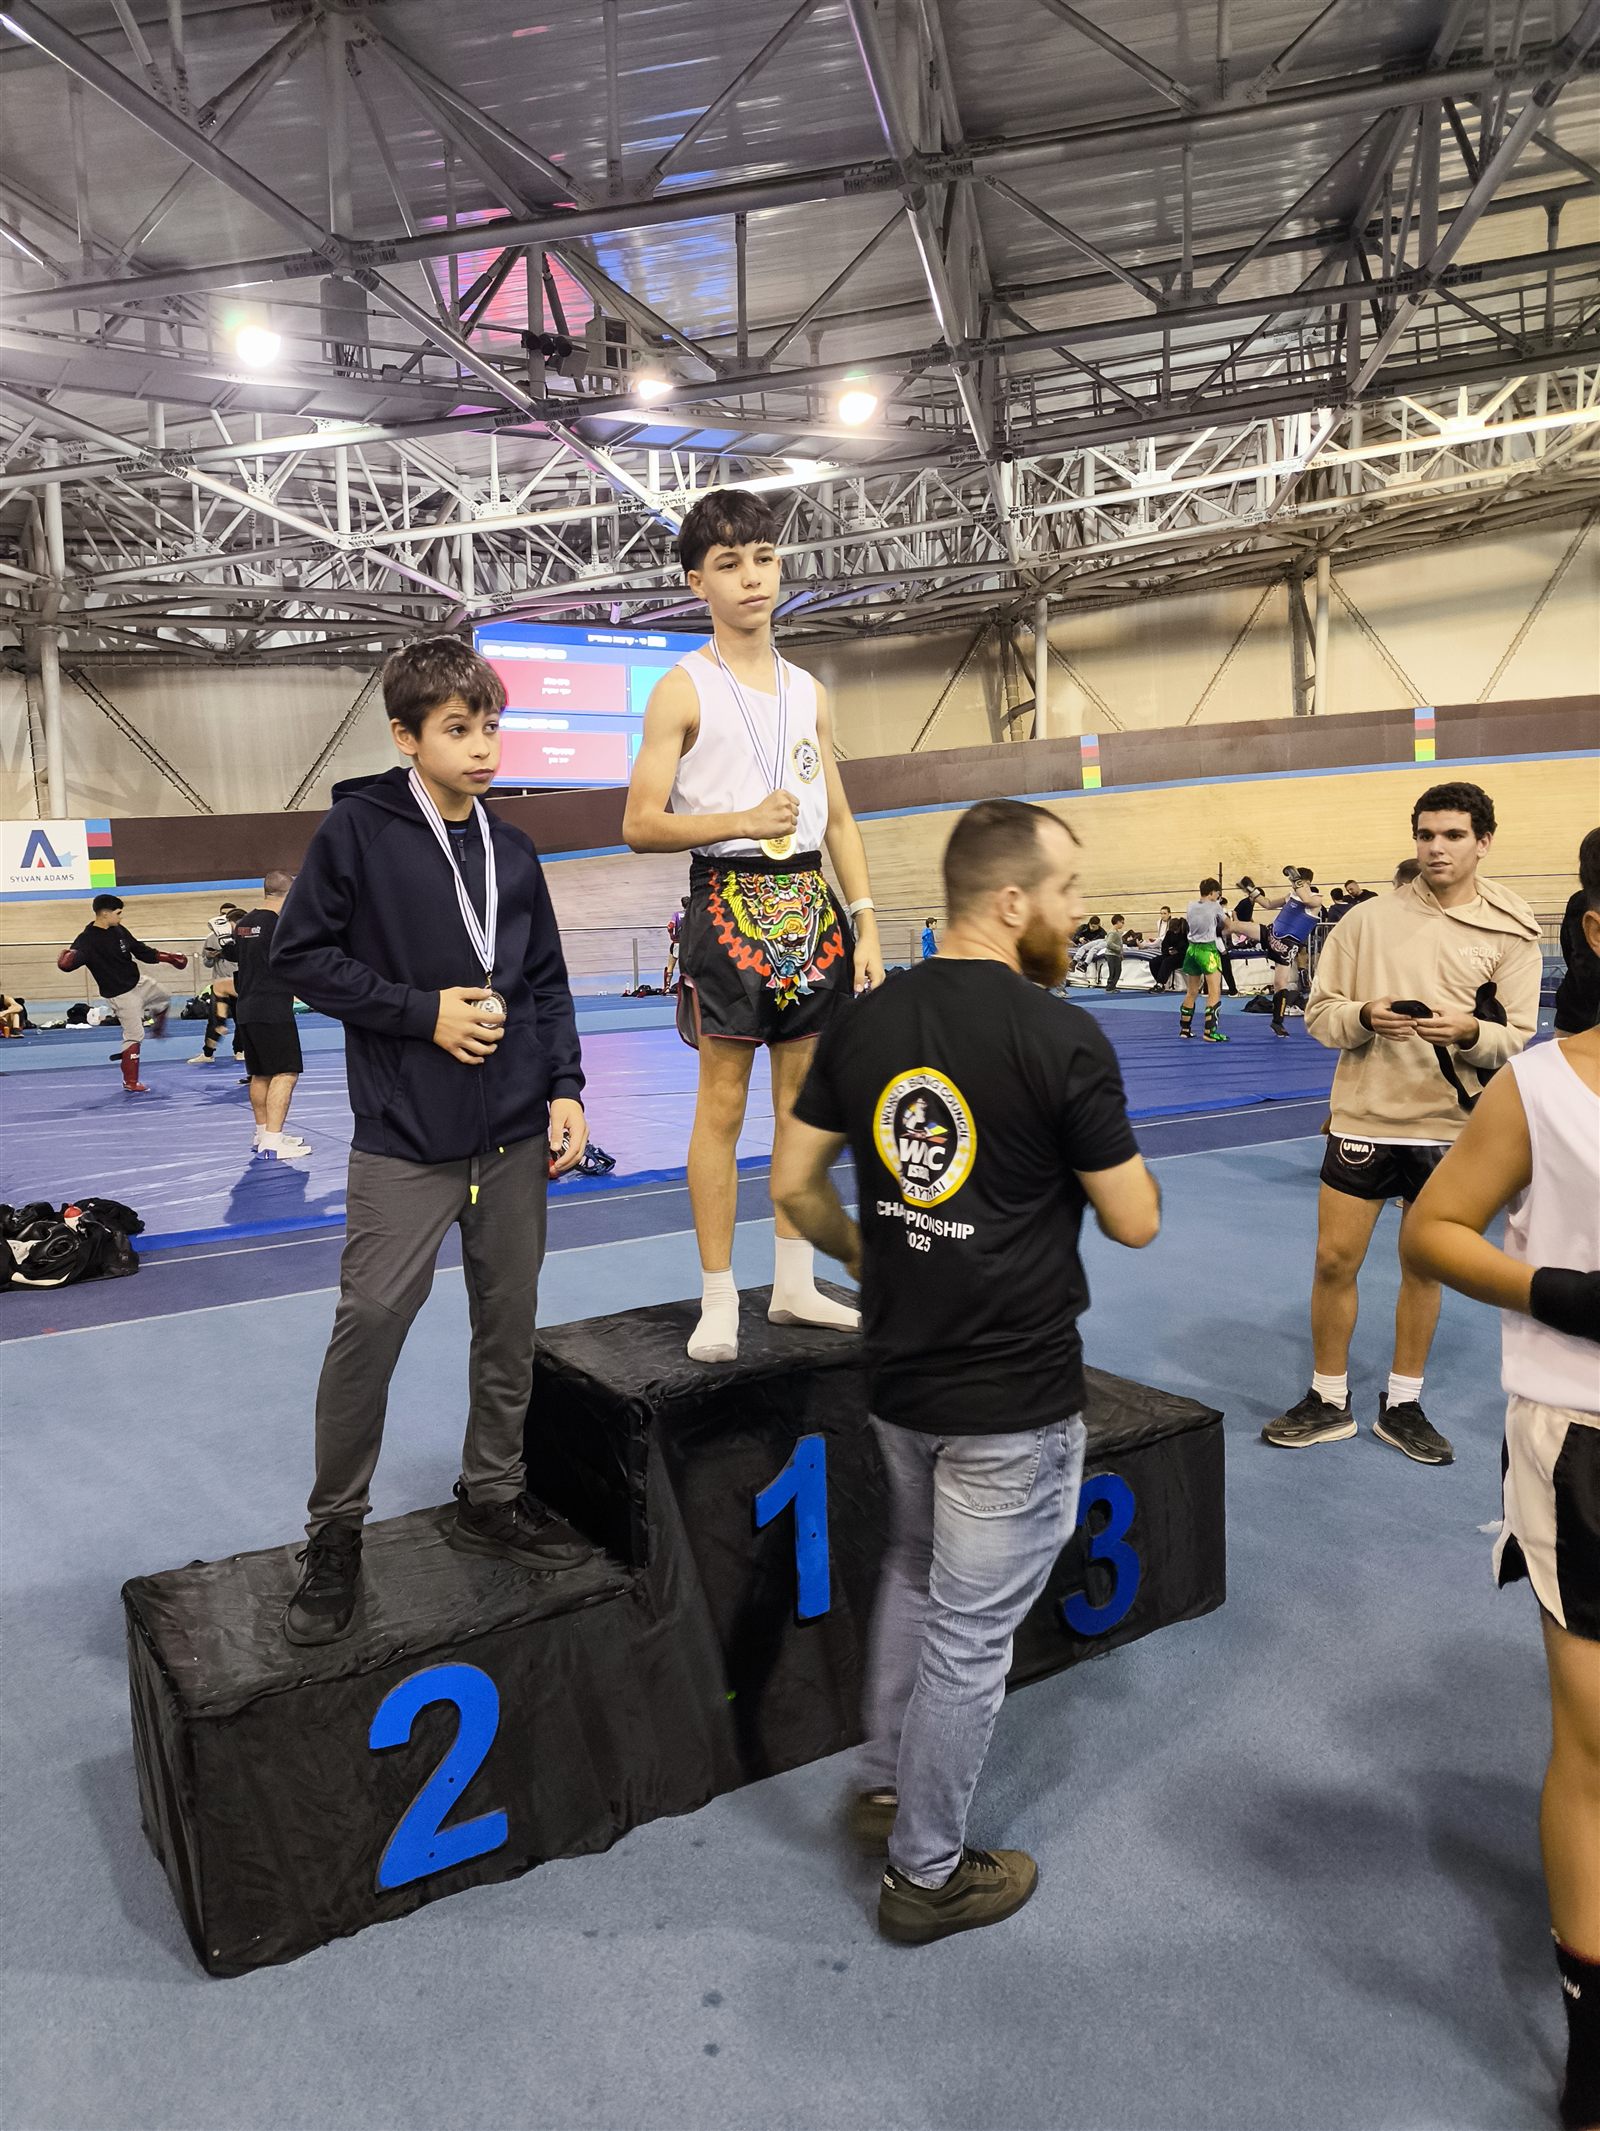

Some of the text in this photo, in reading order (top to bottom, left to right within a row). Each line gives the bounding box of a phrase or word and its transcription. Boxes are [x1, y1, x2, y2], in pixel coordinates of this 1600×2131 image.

[9, 875, 41, 883] SYLVAN
[940, 1086, 970, 1140] COUNCIL
[899, 1138, 946, 1171] WC
[1343, 1141, 1370, 1153] UWA
[876, 1200, 975, 1239] CHAPIONSHIP
[906, 1230, 931, 1252] 025
[755, 1433, 831, 1620] 1
[1060, 1472, 1140, 1636] 3
[368, 1661, 510, 1890] 2
